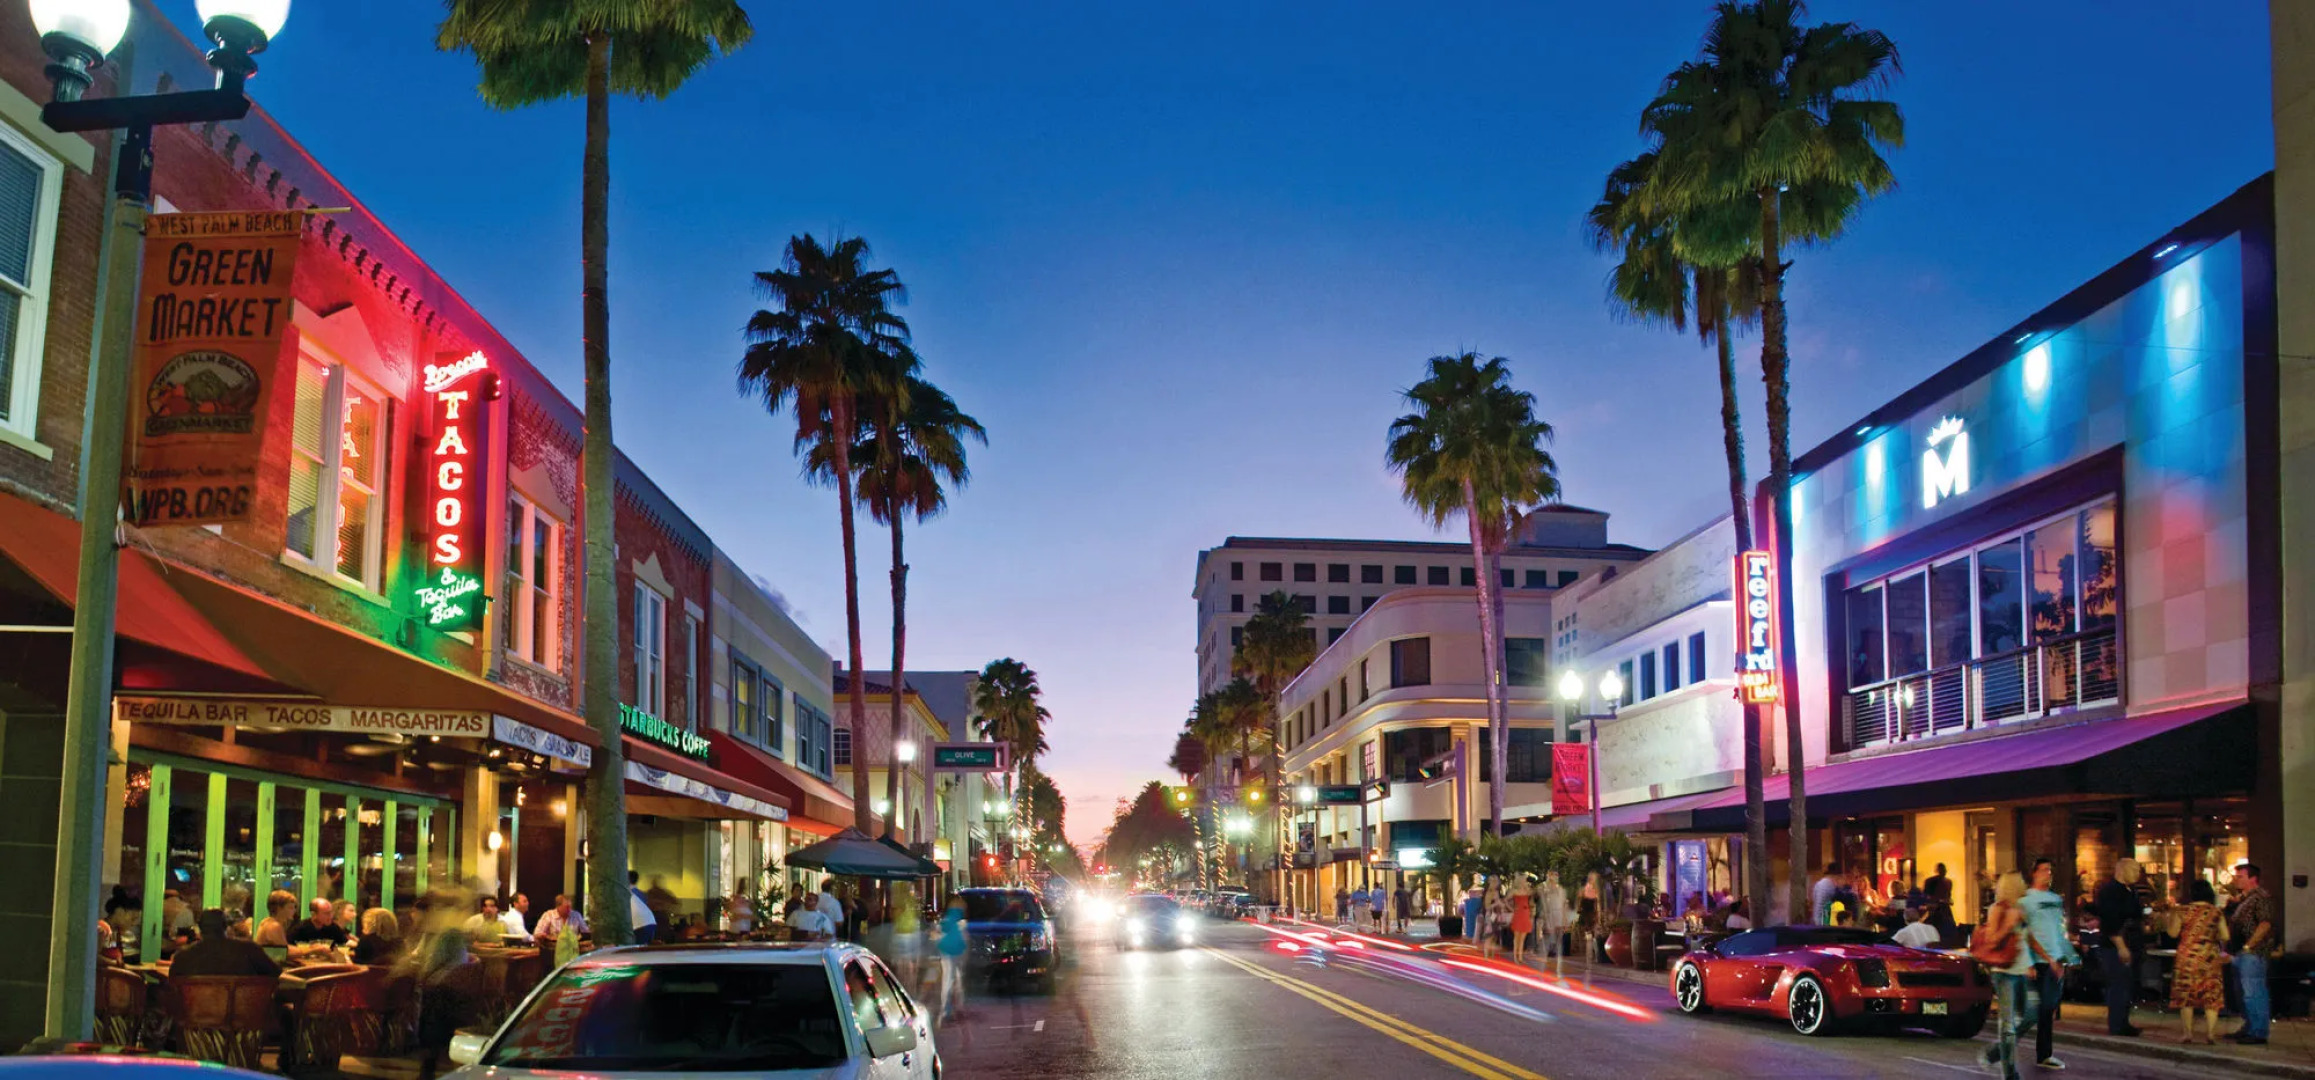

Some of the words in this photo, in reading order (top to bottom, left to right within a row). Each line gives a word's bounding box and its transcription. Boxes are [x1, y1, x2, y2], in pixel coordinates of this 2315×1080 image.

[159, 216, 194, 235] WEST
[203, 216, 239, 233] PALM
[246, 213, 293, 232] BEACH
[168, 242, 274, 286] GREEN
[150, 293, 281, 341] MARKET
[434, 390, 468, 564] TACOS
[415, 576, 480, 608] Tequila
[440, 567, 456, 586] &
[429, 603, 465, 625] Bar
[118, 701, 200, 721] TEQUILA
[206, 704, 248, 722] BAR
[265, 706, 332, 725] TACOS
[350, 710, 483, 732] MARGARITAS
[618, 702, 679, 748] STARBUCKS
